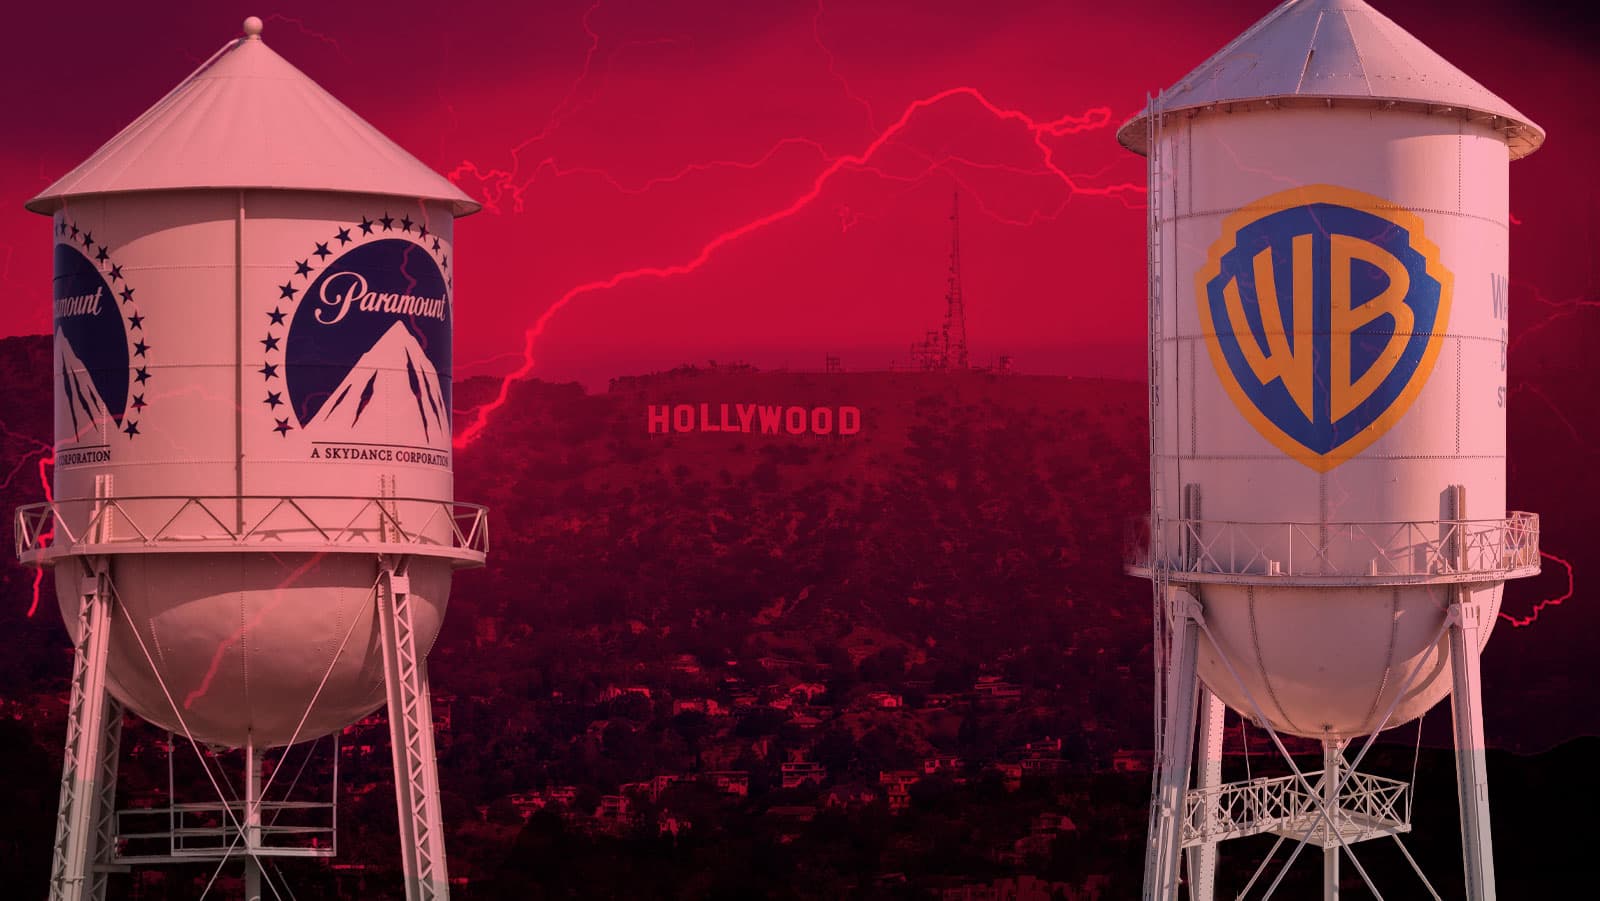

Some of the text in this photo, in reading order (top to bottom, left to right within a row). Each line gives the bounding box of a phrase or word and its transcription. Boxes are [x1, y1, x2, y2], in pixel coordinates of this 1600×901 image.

[314, 271, 446, 325] Paramount
[1223, 233, 1415, 424] WB
[648, 403, 861, 435] HOLLYWOOD
[311, 447, 449, 467] A SKYDANCE CORPORATION
